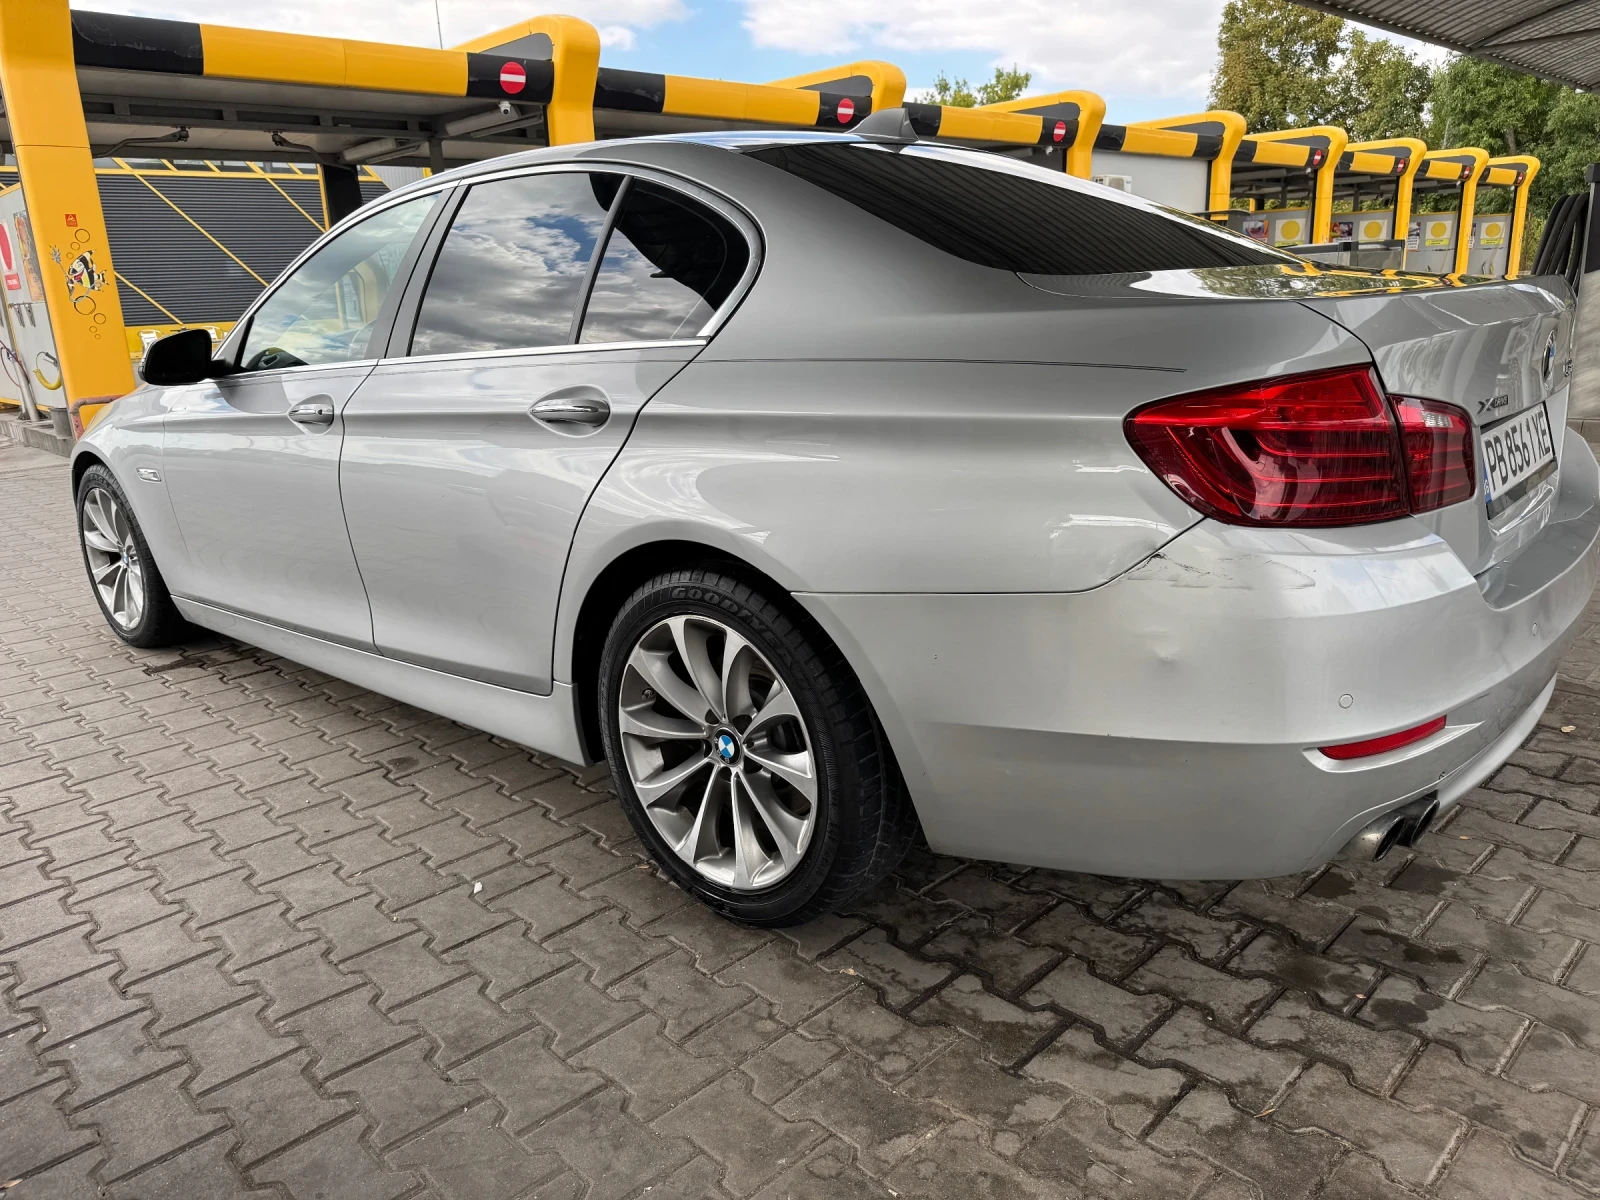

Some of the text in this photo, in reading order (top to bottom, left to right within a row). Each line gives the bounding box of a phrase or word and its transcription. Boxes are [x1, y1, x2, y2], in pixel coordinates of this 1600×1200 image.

[1484, 409, 1551, 492] PB 8561 XE
[671, 587, 813, 691] GOODYEAR
